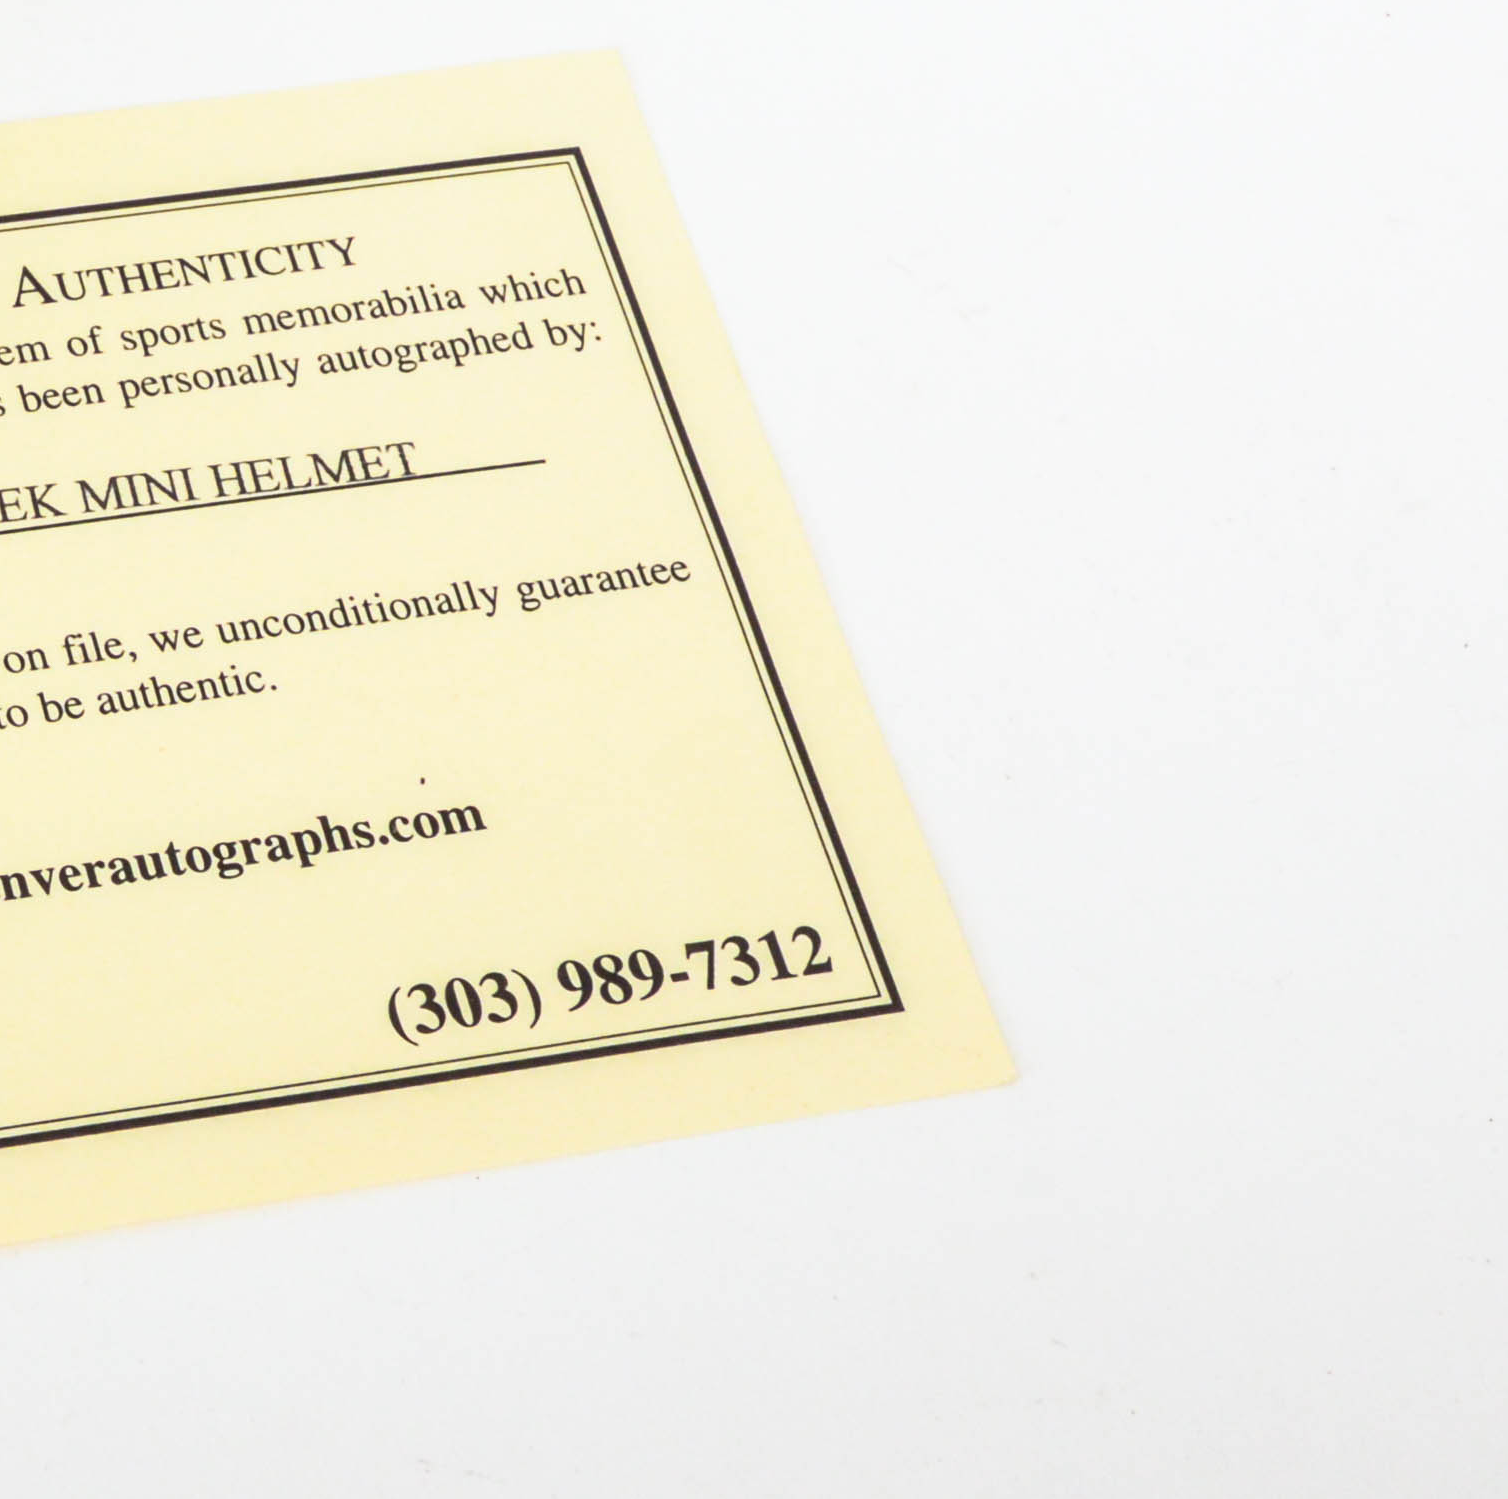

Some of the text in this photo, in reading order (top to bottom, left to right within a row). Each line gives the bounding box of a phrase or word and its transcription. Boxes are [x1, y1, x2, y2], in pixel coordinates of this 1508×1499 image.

[66, 324, 103, 358] of
[119, 317, 227, 358] sports
[242, 284, 467, 336] memorabilia
[478, 267, 587, 305] which
[16, 382, 106, 414] been
[117, 351, 300, 410] personally
[316, 320, 535, 376] autographed
[541, 317, 604, 353] by:
[75, 466, 198, 514] MINI
[207, 441, 415, 499] HELMET
[2, 647, 51, 675] on
[62, 630, 138, 667] file,
[147, 626, 205, 653] we
[215, 579, 499, 645] unconditionally
[516, 560, 692, 613] guarantee
[35, 691, 86, 724] be
[96, 663, 278, 716] authentic.
[387, 924, 834, 1048] (303) 989-7312
